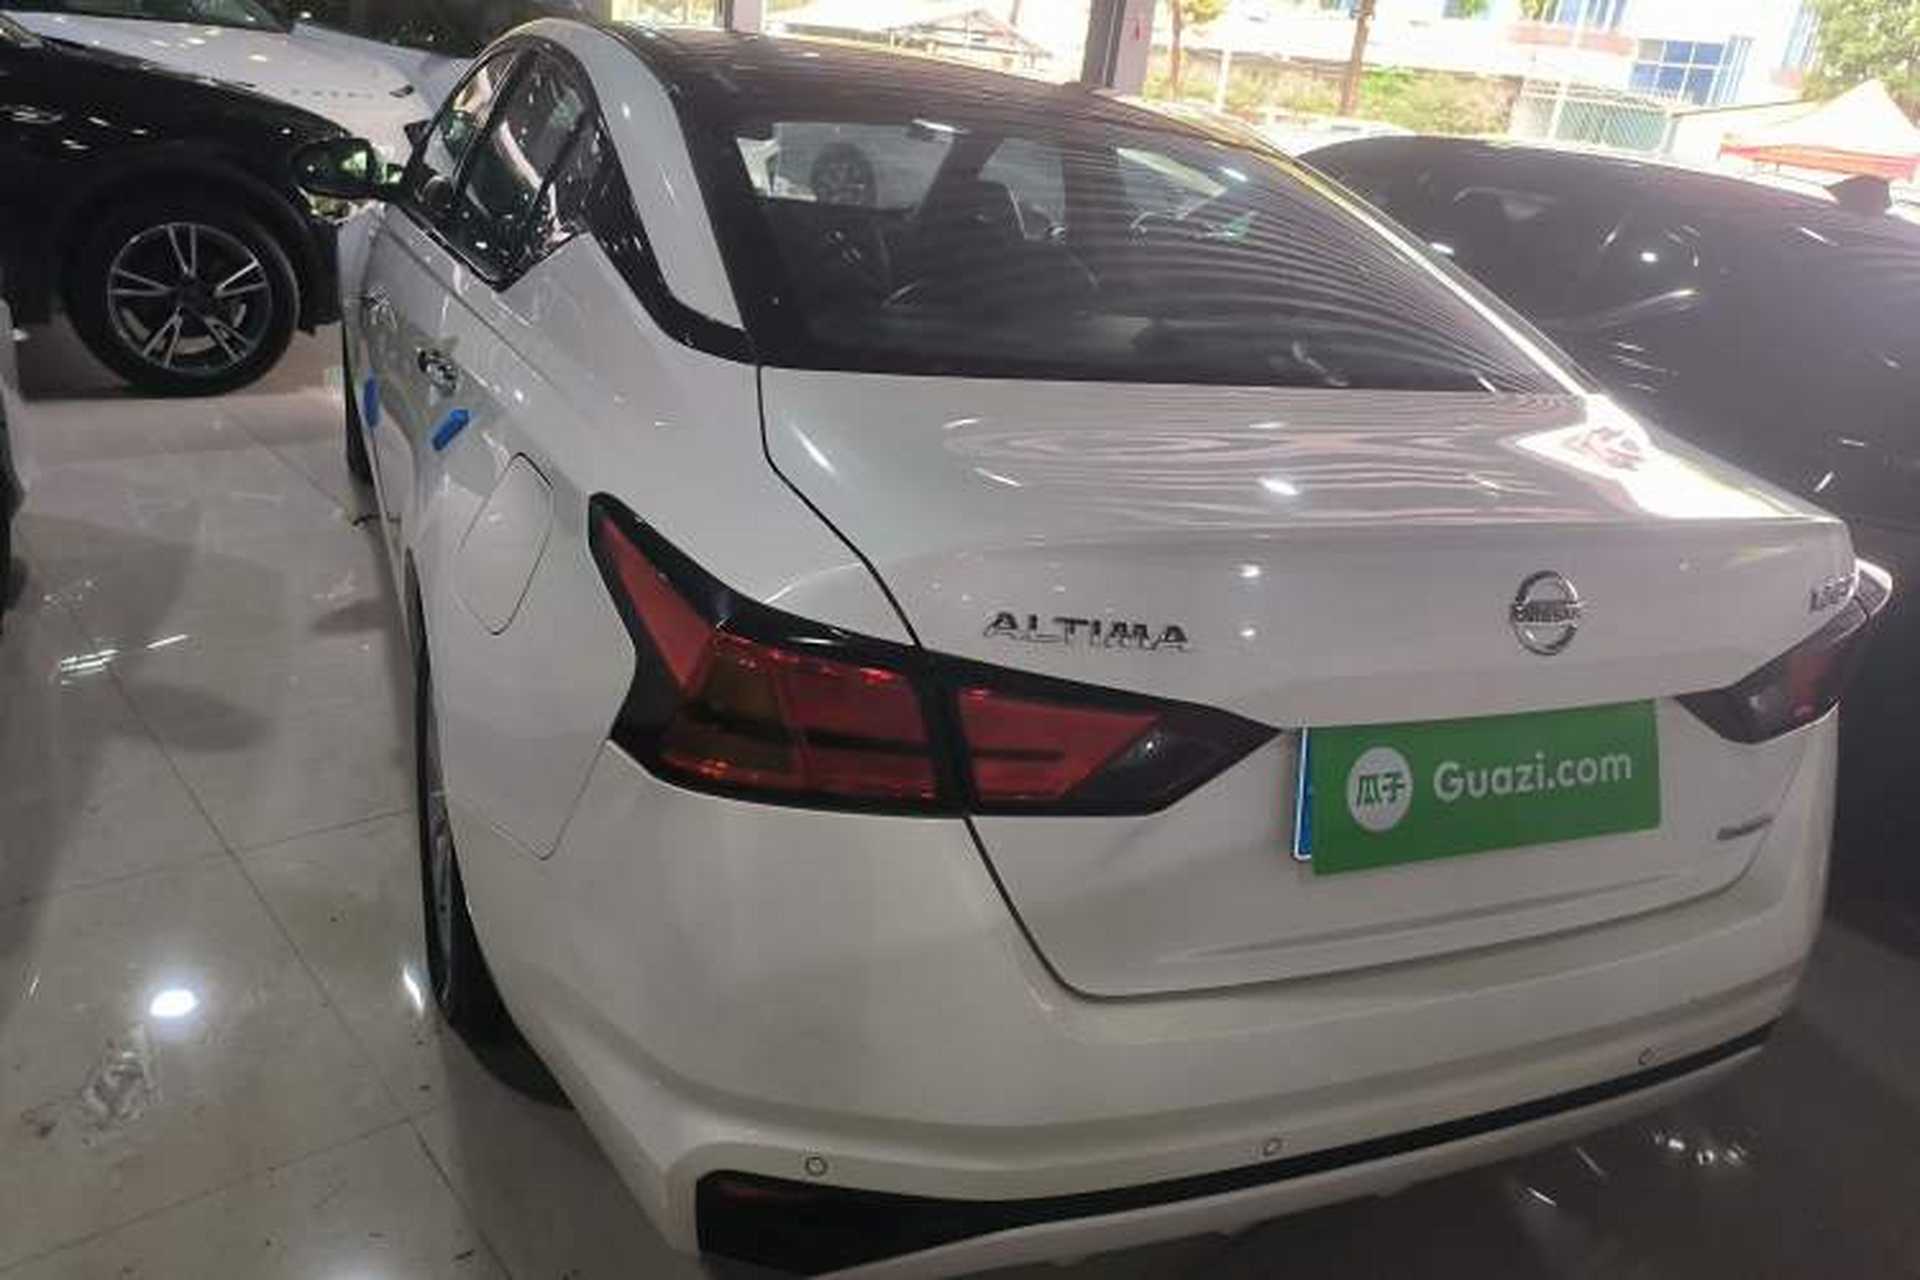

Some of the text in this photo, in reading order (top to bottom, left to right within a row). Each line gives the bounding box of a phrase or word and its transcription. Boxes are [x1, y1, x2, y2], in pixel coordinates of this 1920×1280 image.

[983, 611, 1190, 652] ALTIMA
[1356, 771, 1406, 808] 瓜子
[1432, 750, 1633, 802] Guazi.com
